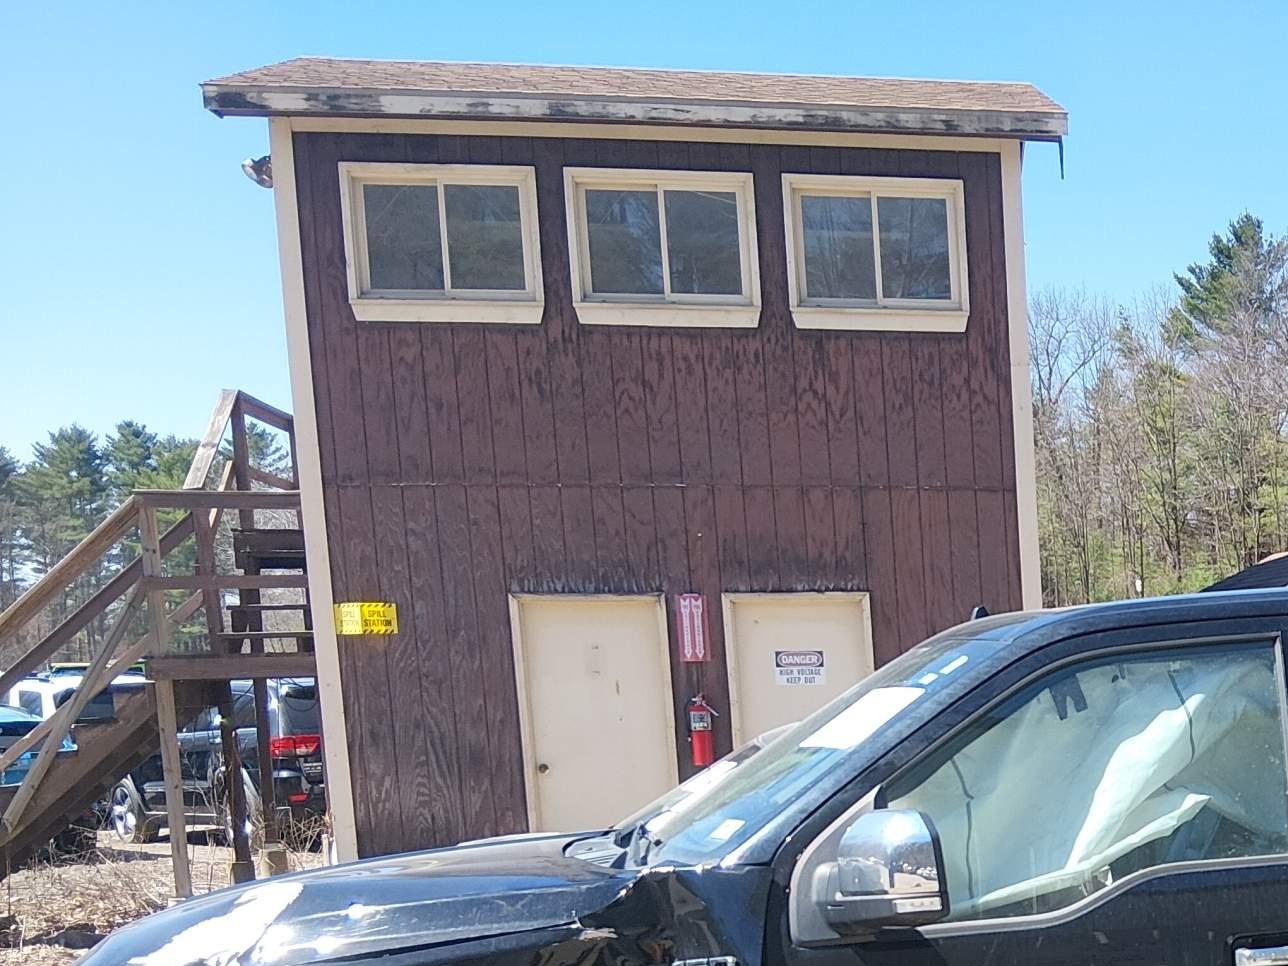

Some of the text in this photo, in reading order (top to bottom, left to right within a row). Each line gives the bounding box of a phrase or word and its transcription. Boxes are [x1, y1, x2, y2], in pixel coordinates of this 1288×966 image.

[367, 610, 387, 618] SPILL
[781, 655, 818, 664] DANGER
[779, 668, 821, 676] HIGH VOLTAGE
